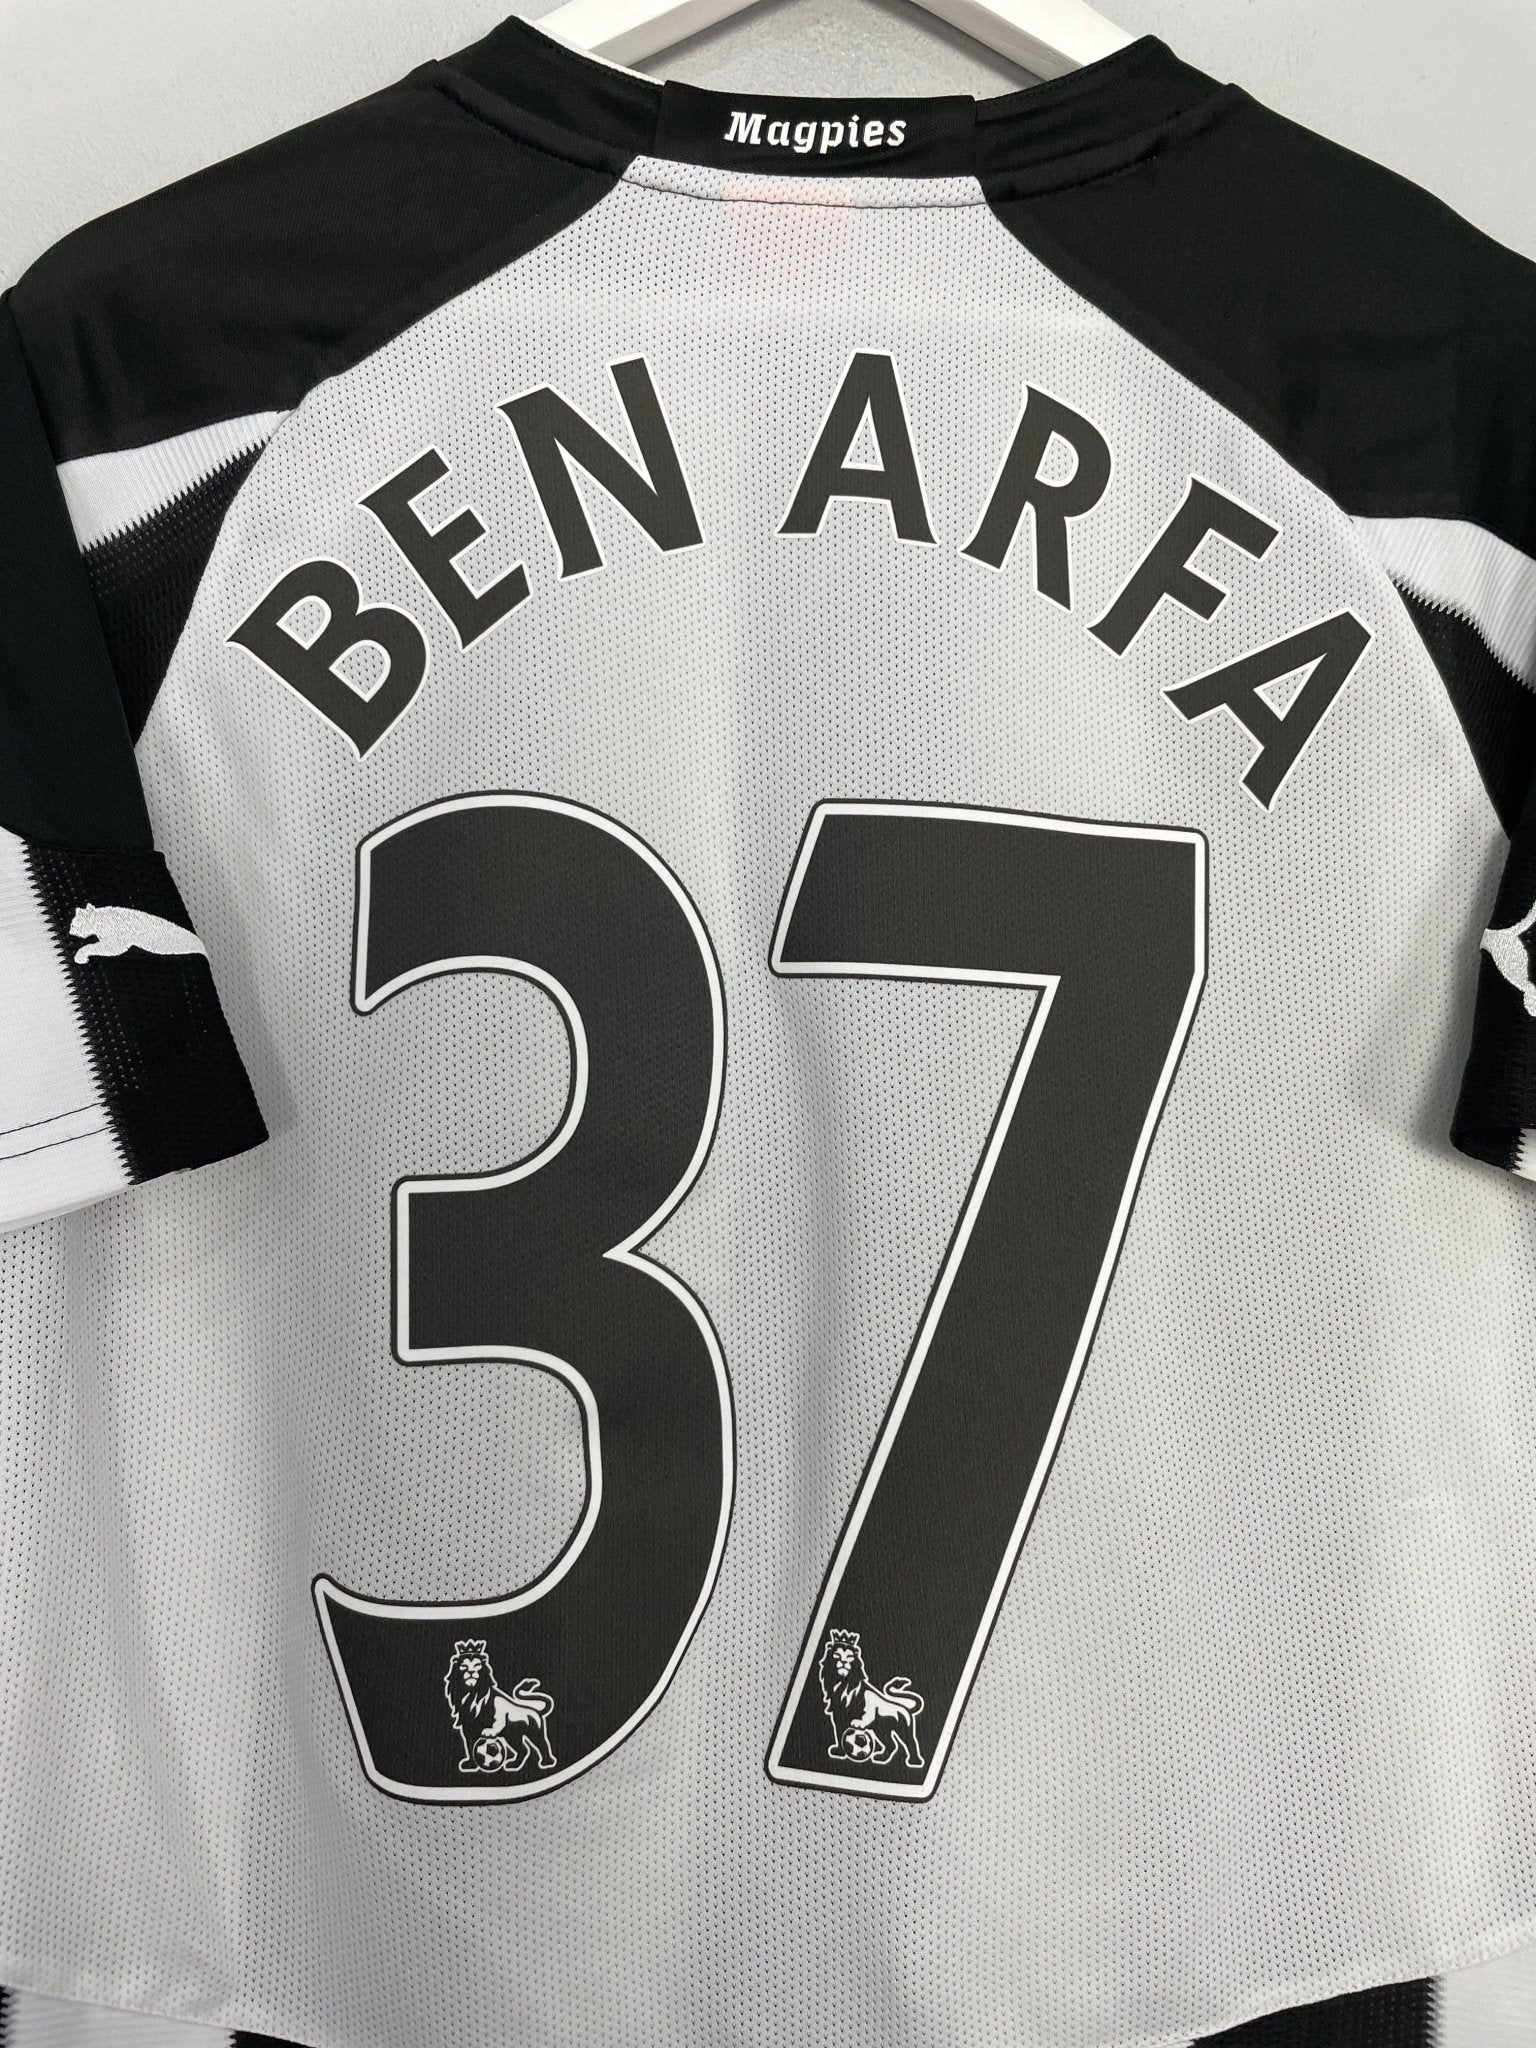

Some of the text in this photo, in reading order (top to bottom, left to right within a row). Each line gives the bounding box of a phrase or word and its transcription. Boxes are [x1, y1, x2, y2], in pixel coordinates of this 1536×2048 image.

[724, 111, 907, 154] Magpies
[227, 349, 1374, 810] BEN ARFA
[312, 789, 1211, 1806] 37
